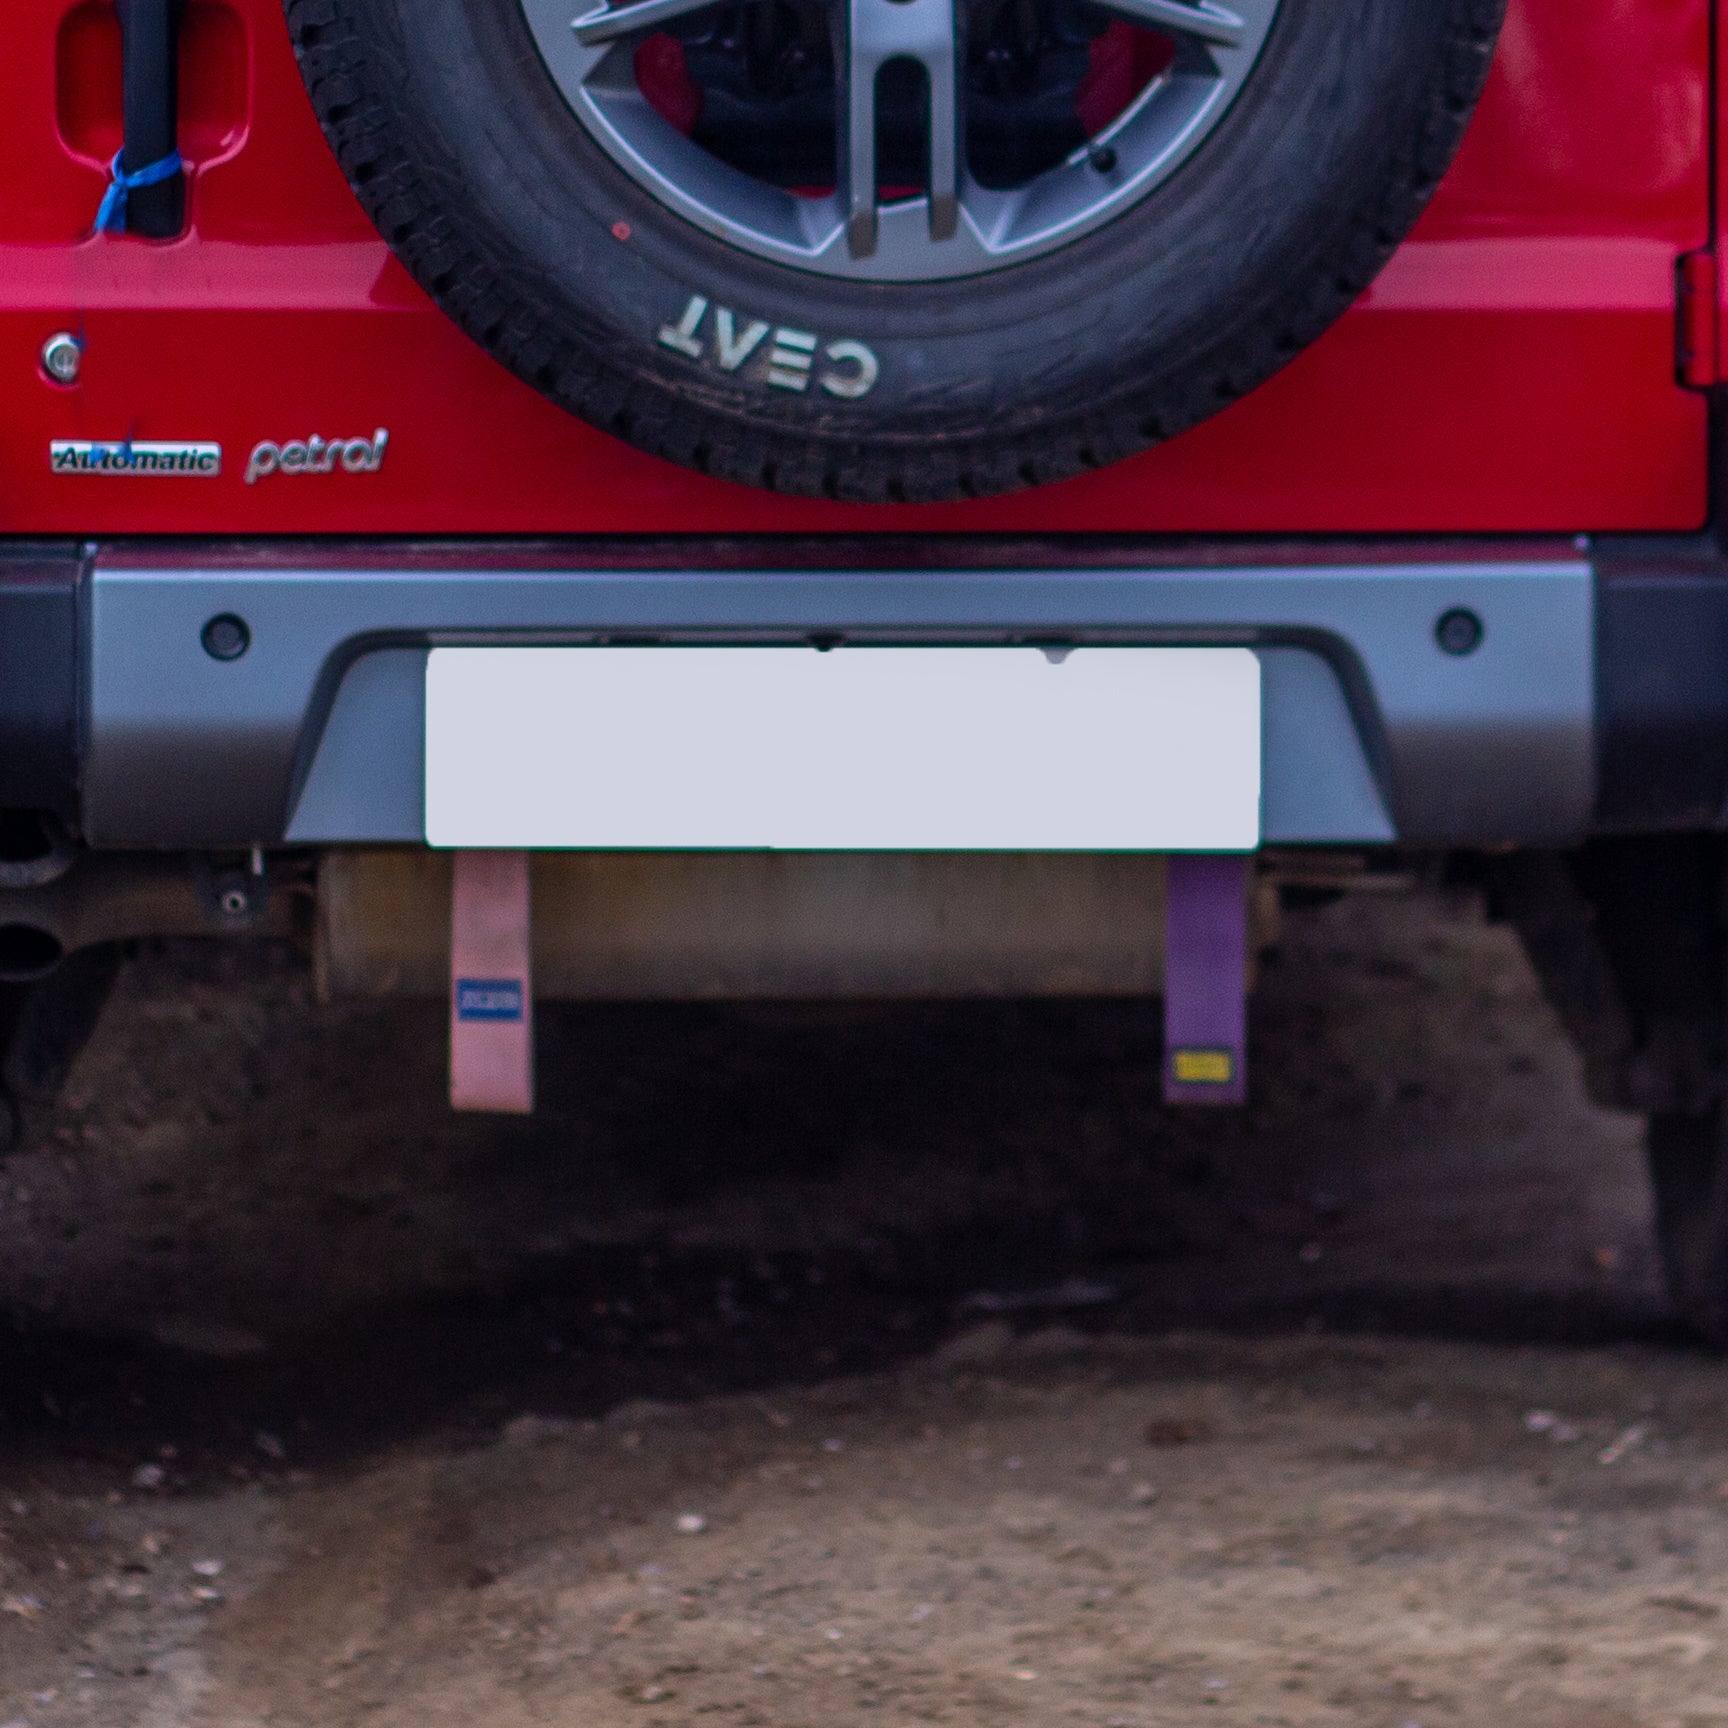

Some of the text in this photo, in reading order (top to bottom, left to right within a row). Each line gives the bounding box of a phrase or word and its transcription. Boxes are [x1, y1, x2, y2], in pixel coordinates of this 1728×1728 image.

[658, 294, 880, 400] CEAT
[54, 427, 390, 485] Automatic petrol
